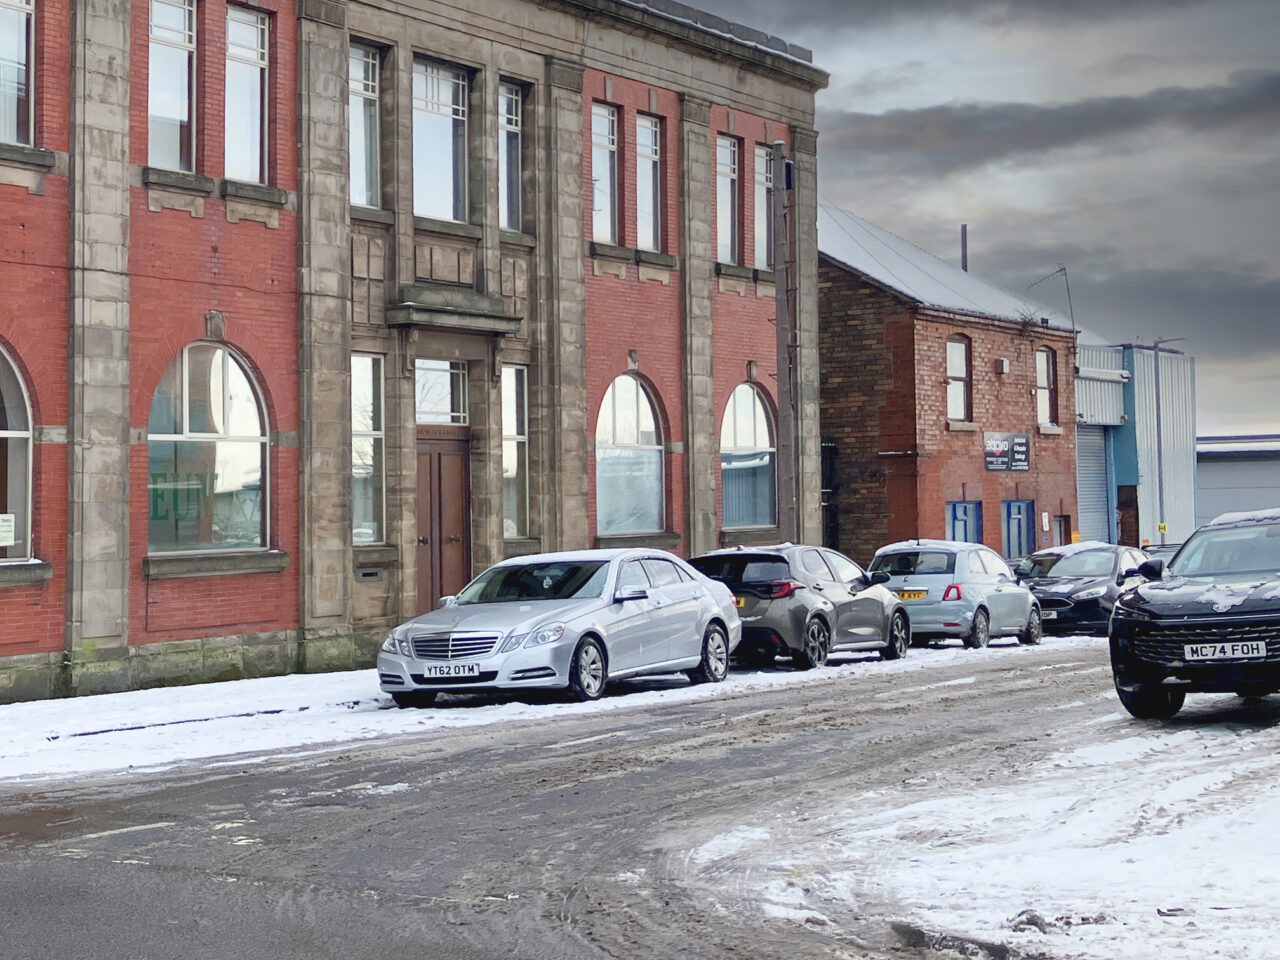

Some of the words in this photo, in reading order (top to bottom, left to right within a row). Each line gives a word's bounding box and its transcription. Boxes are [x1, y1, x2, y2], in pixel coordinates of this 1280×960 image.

[1190, 645, 1228, 658] MC74
[1231, 643, 1260, 656] FOH
[427, 665, 452, 676] YT62
[454, 664, 475, 675] OTM
